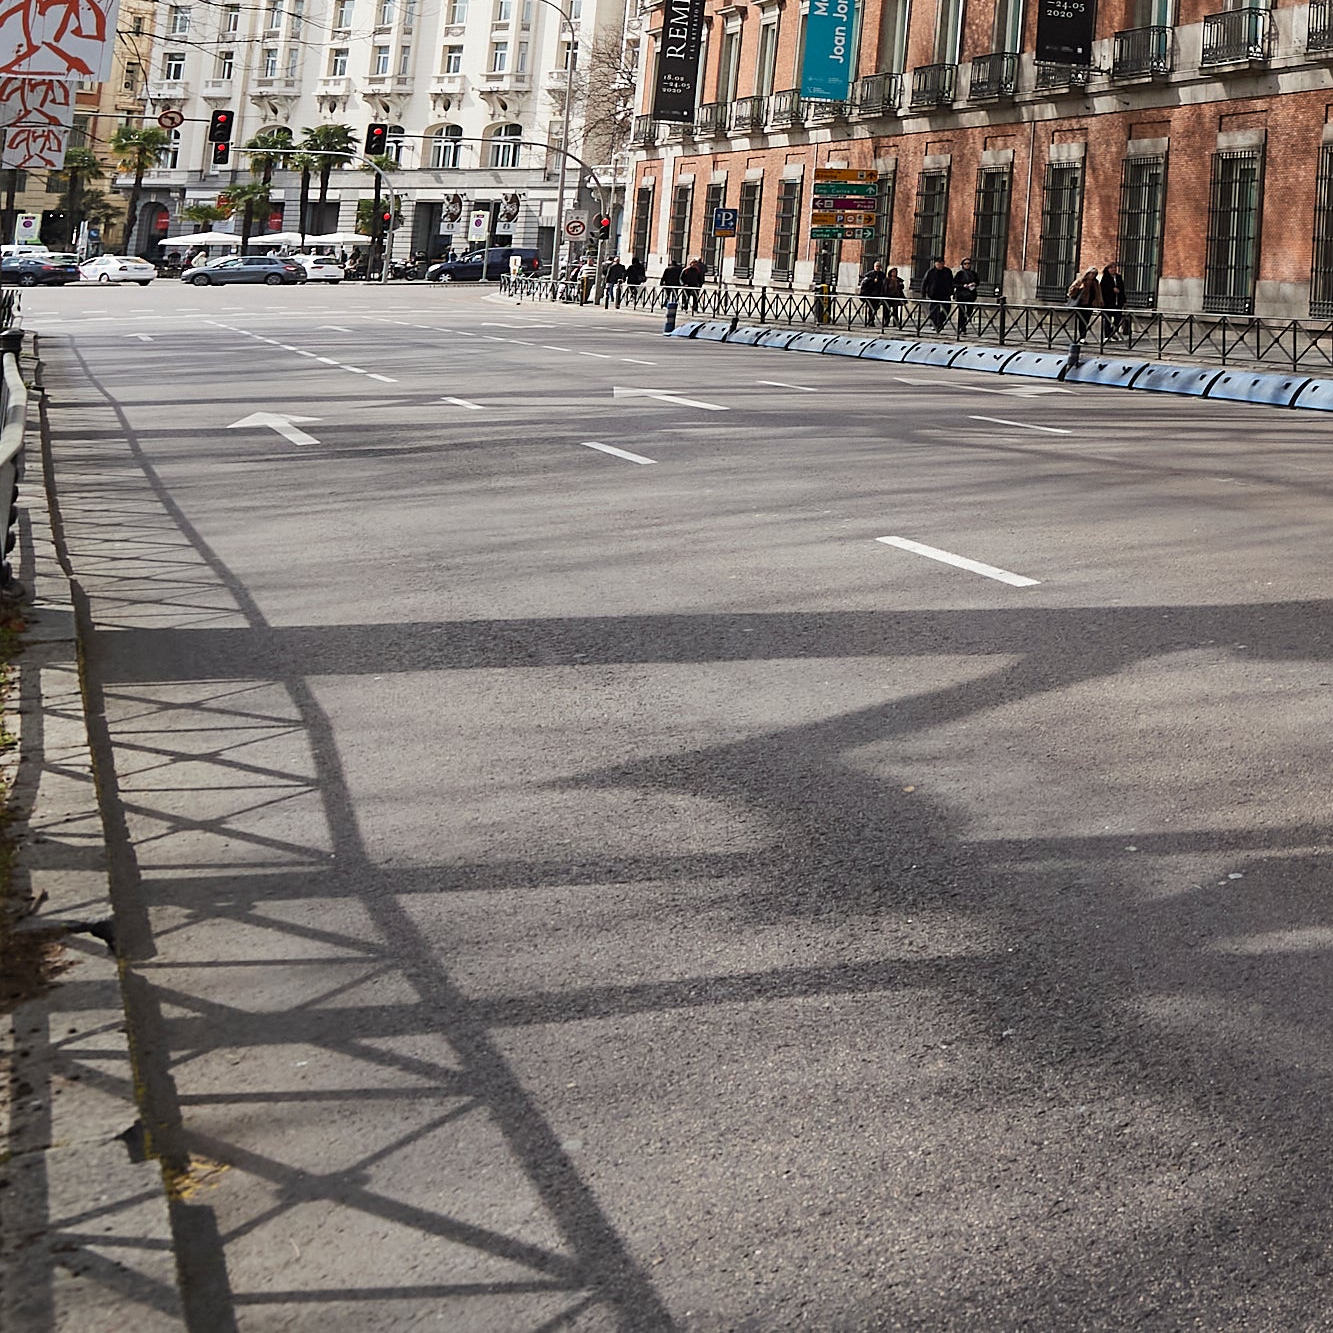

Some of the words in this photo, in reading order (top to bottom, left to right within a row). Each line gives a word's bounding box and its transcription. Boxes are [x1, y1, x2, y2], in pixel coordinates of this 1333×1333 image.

[1046, 9, 1073, 18] 2020
[829, 26, 846, 64] Joan
[663, 73, 685, 82] 18.02
[720, 211, 734, 227] P
